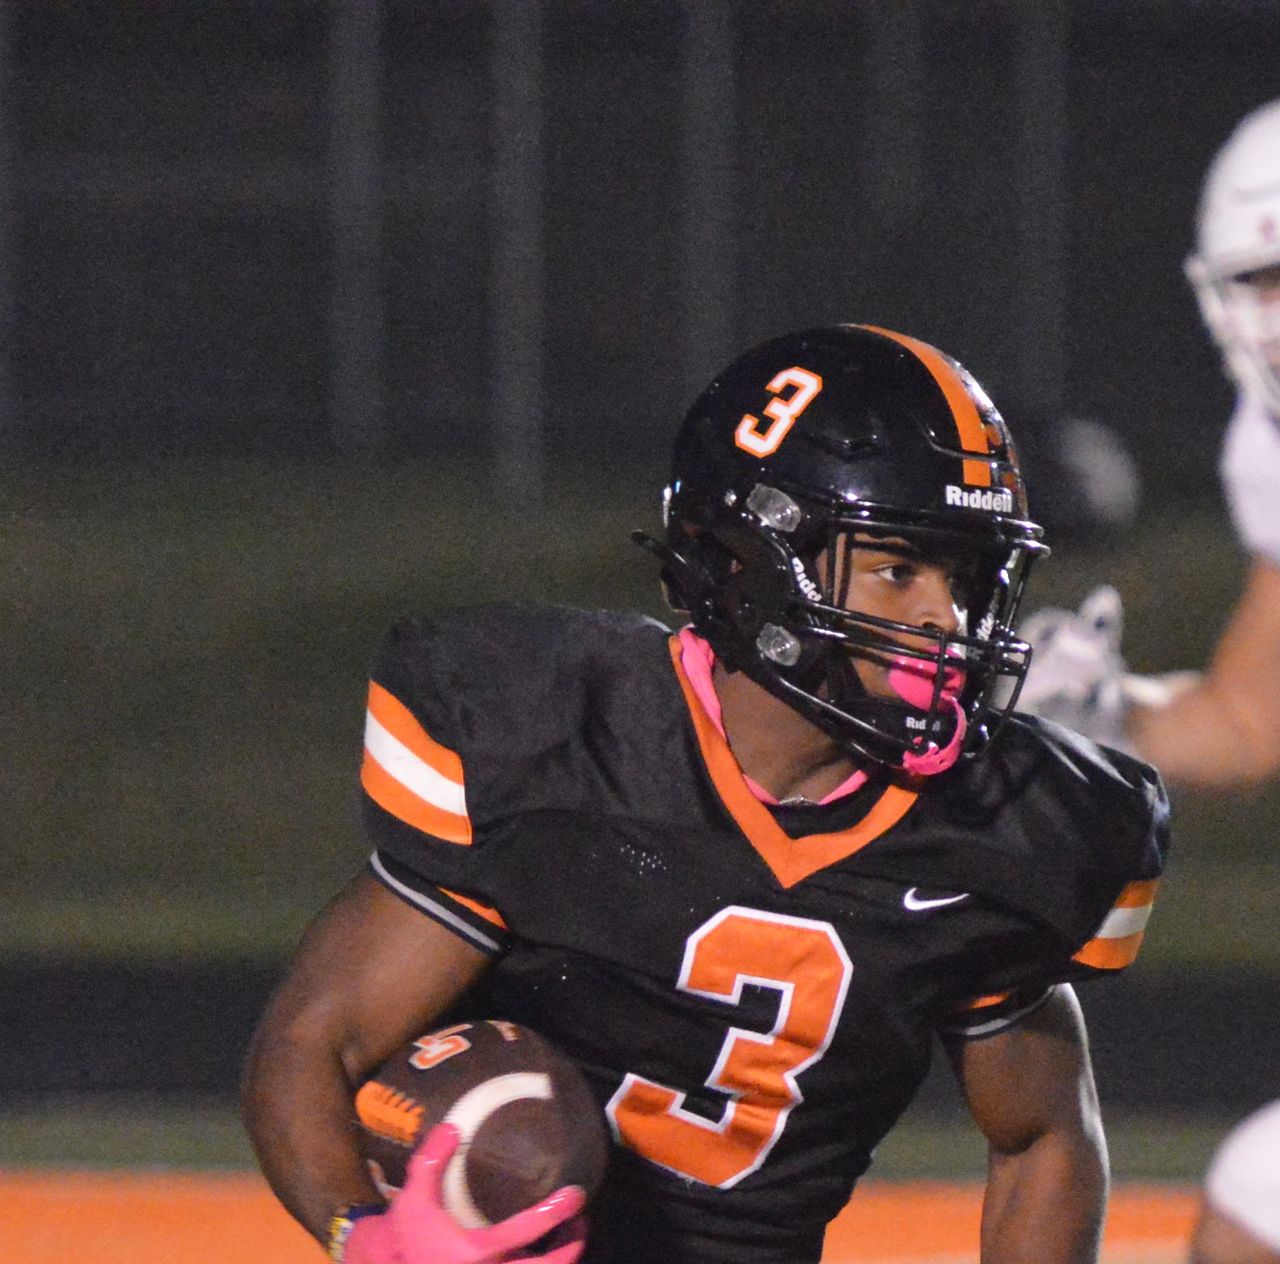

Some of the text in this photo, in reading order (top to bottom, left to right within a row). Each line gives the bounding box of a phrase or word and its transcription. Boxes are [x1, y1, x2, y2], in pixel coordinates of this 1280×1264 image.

[734, 365, 823, 459] 3
[945, 484, 1013, 513] Riddell
[605, 905, 853, 1189] 3
